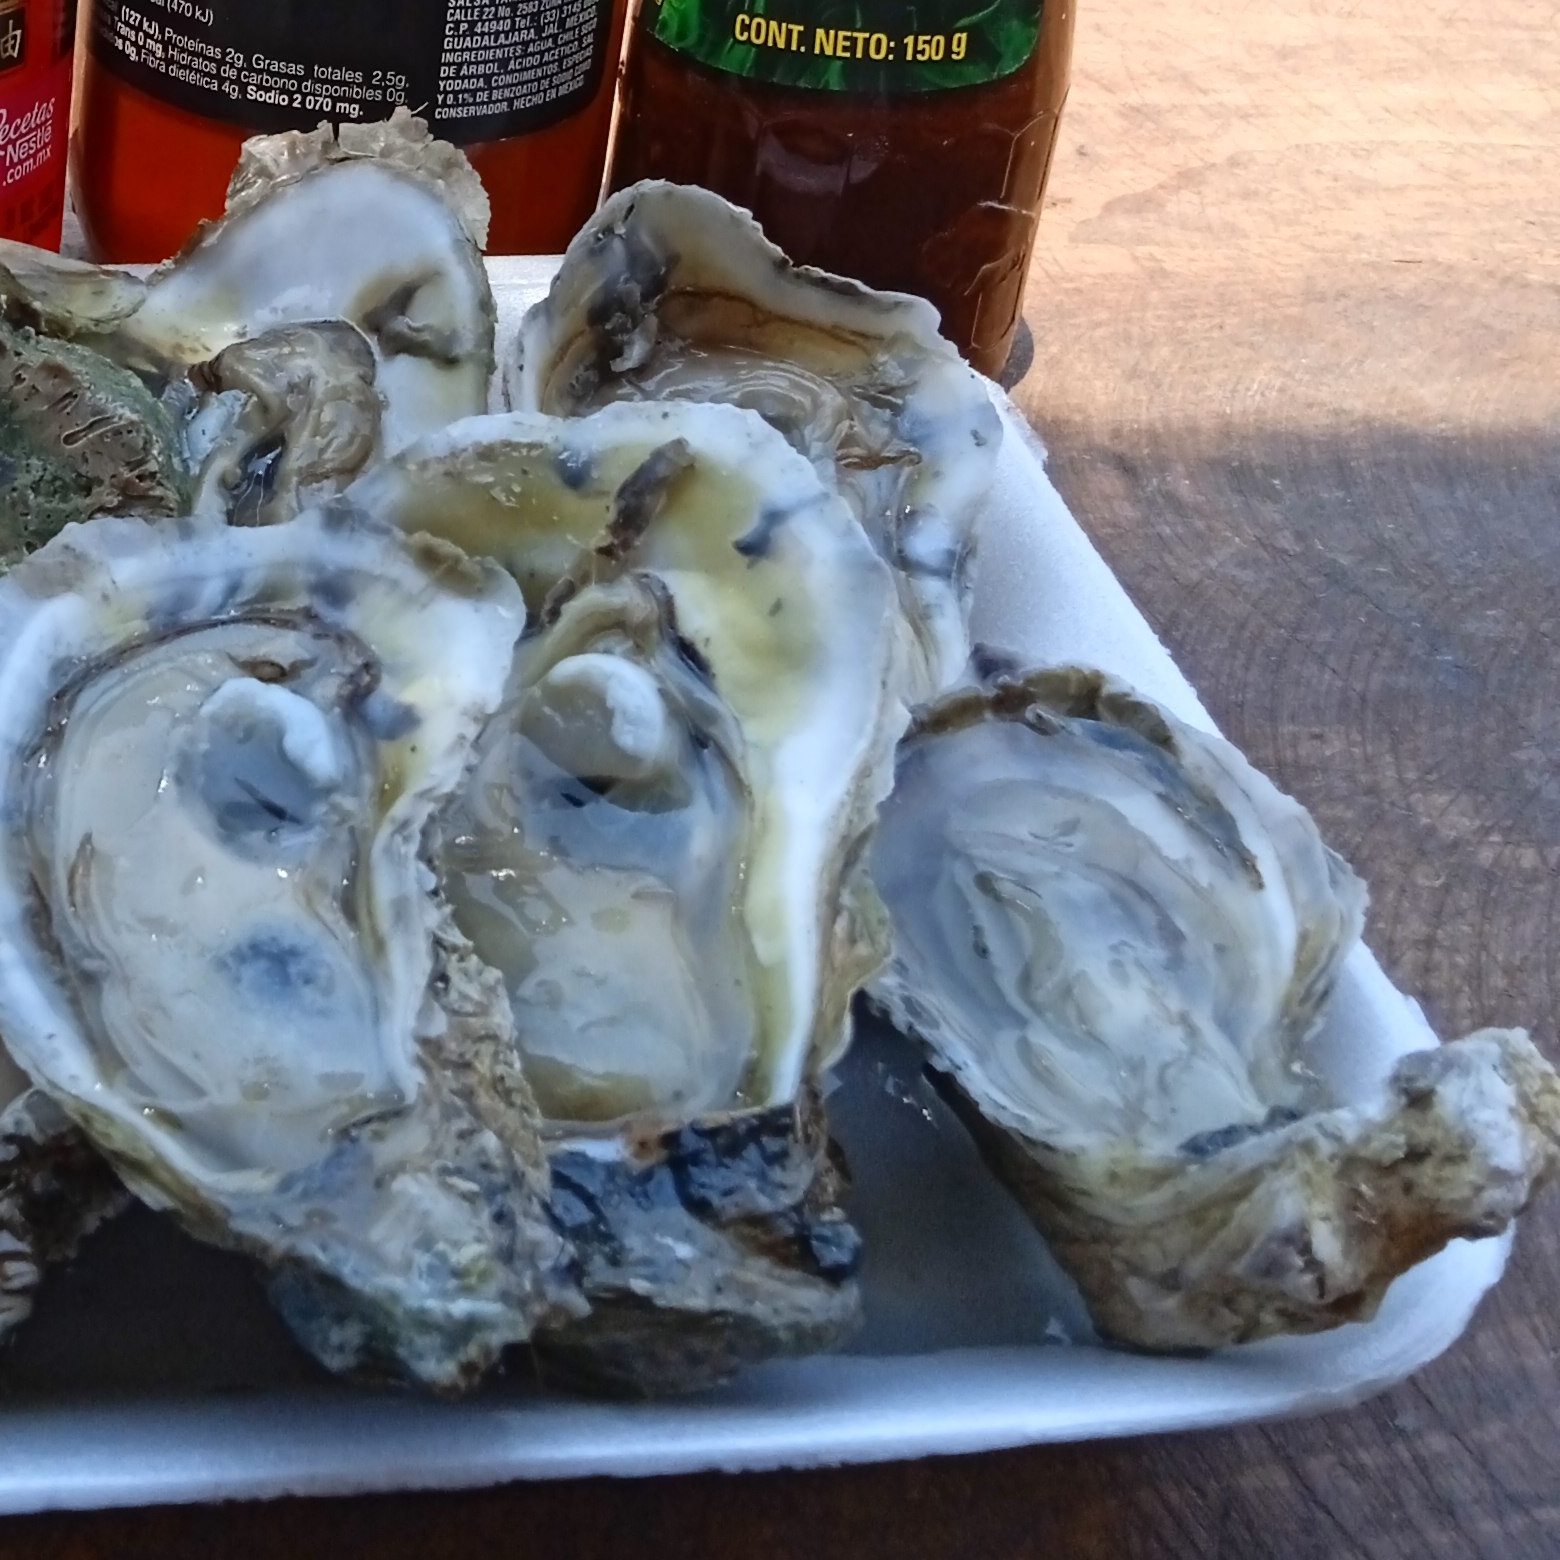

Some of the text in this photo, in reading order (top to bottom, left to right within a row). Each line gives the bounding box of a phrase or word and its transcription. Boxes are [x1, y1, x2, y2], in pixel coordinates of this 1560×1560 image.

[195, 5, 214, 26] kJ)
[446, 7, 480, 21] CALLE
[482, 7, 495, 19] 22
[497, 5, 513, 18] No.
[474, 19, 511, 34] 44940
[541, 8, 560, 26] (33)
[121, 5, 142, 27] (127
[165, 27, 222, 59] Proteínas
[252, 54, 305, 76] Grasas
[314, 64, 363, 83] totales
[734, 14, 968, 61] CONT. NETO: 150 g
[141, 50, 166, 73] Fibra
[168, 64, 218, 91] dietética
[246, 85, 289, 106] Sodio
[292, 93, 302, 108] 2
[305, 95, 332, 112] 070
[335, 101, 364, 118] mg.
[168, 45, 217, 75] Hidratos
[220, 64, 237, 80] de
[241, 70, 298, 91] carbono
[301, 79, 382, 101] disponibles
[440, 65, 457, 78] DE
[437, 93, 445, 105] Y
[476, 90, 489, 102] DE
[491, 81, 539, 100] BENZOATO
[540, 77, 550, 90] DE
[513, 91, 544, 110] HECHO
[545, 87, 557, 102] EN
[6, 120, 53, 166] Nestlé
